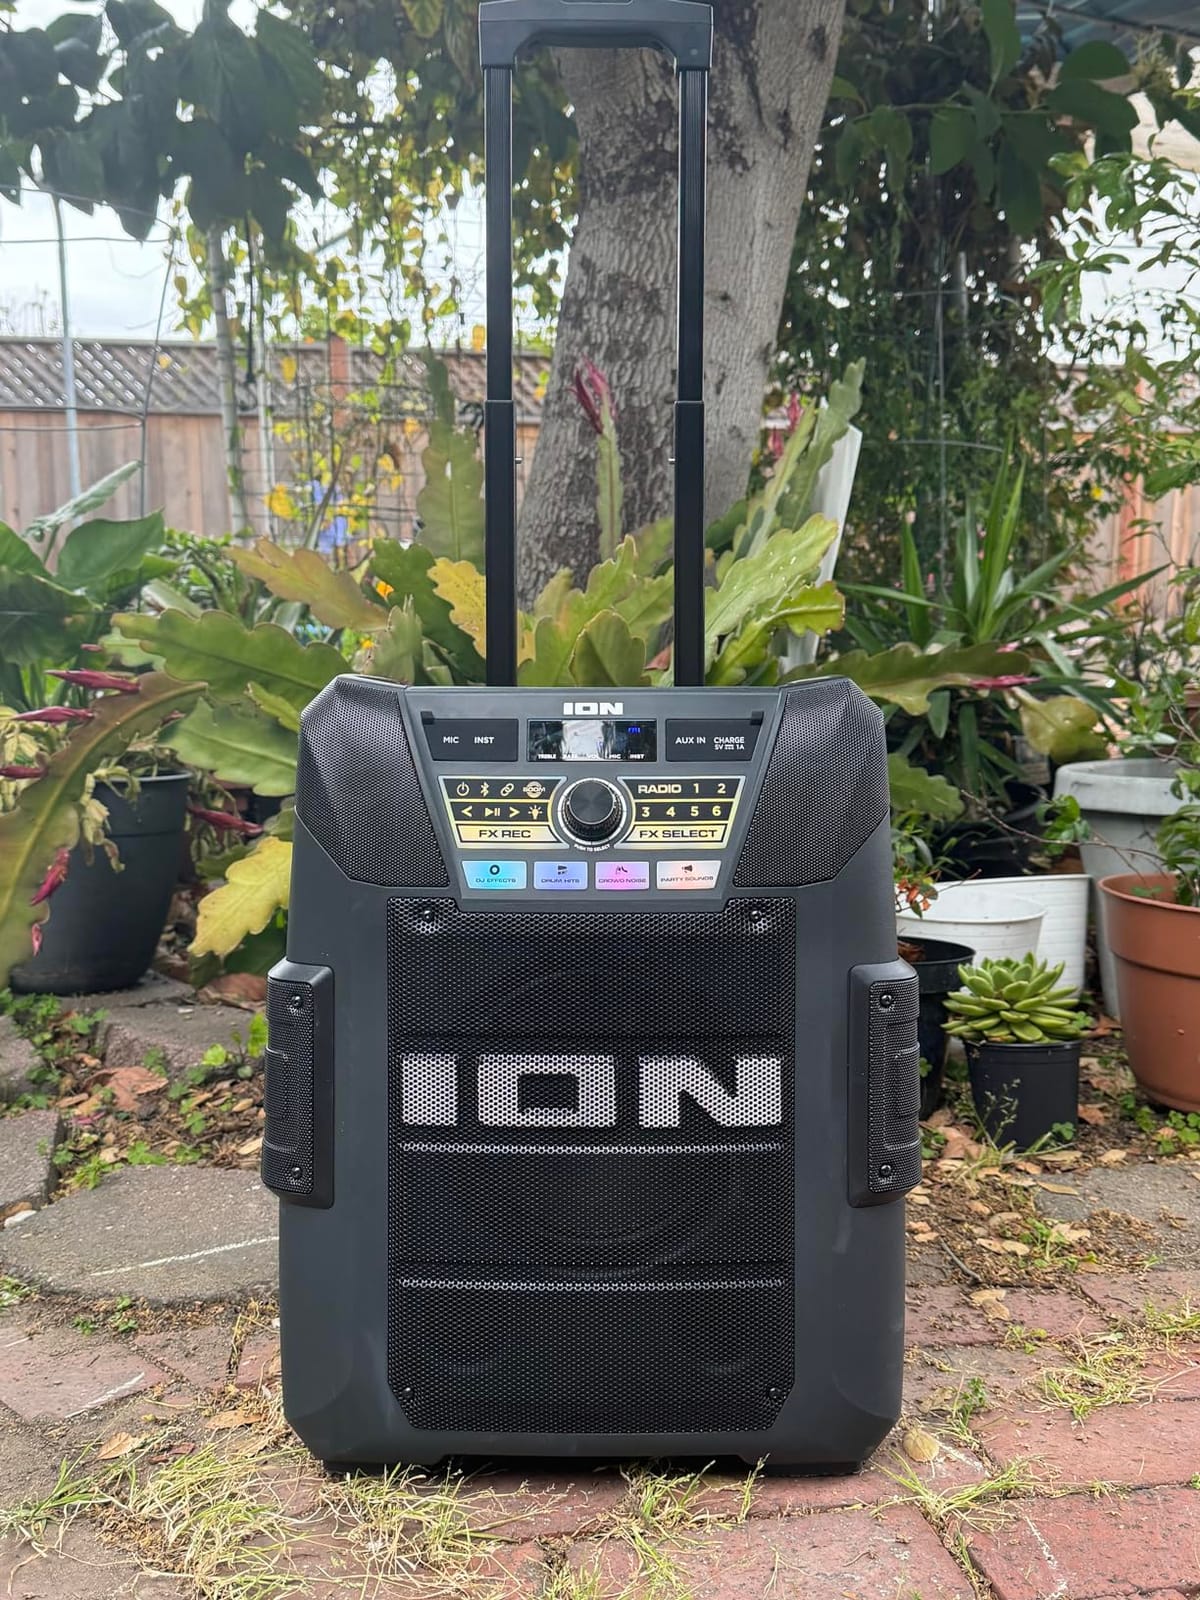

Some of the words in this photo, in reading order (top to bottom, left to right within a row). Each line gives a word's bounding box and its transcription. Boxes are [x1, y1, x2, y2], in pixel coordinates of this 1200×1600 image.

[563, 702, 623, 715] ION
[443, 736, 460, 744] MIC
[473, 736, 495, 744] INST
[675, 736, 695, 744] AUX
[696, 736, 706, 744] IN
[713, 736, 745, 744] CHARGE
[638, 784, 682, 794] RADIO
[693, 783, 700, 794] 1
[717, 783, 727, 794] 2
[641, 806, 650, 817] 3
[666, 806, 676, 817] 4
[690, 806, 699, 816] 5
[712, 806, 721, 816] 6
[479, 829, 499, 838] FX
[501, 829, 531, 838] REC
[639, 830, 659, 838] FX
[662, 829, 718, 838] SELECT
[401, 1053, 783, 1128] ION
